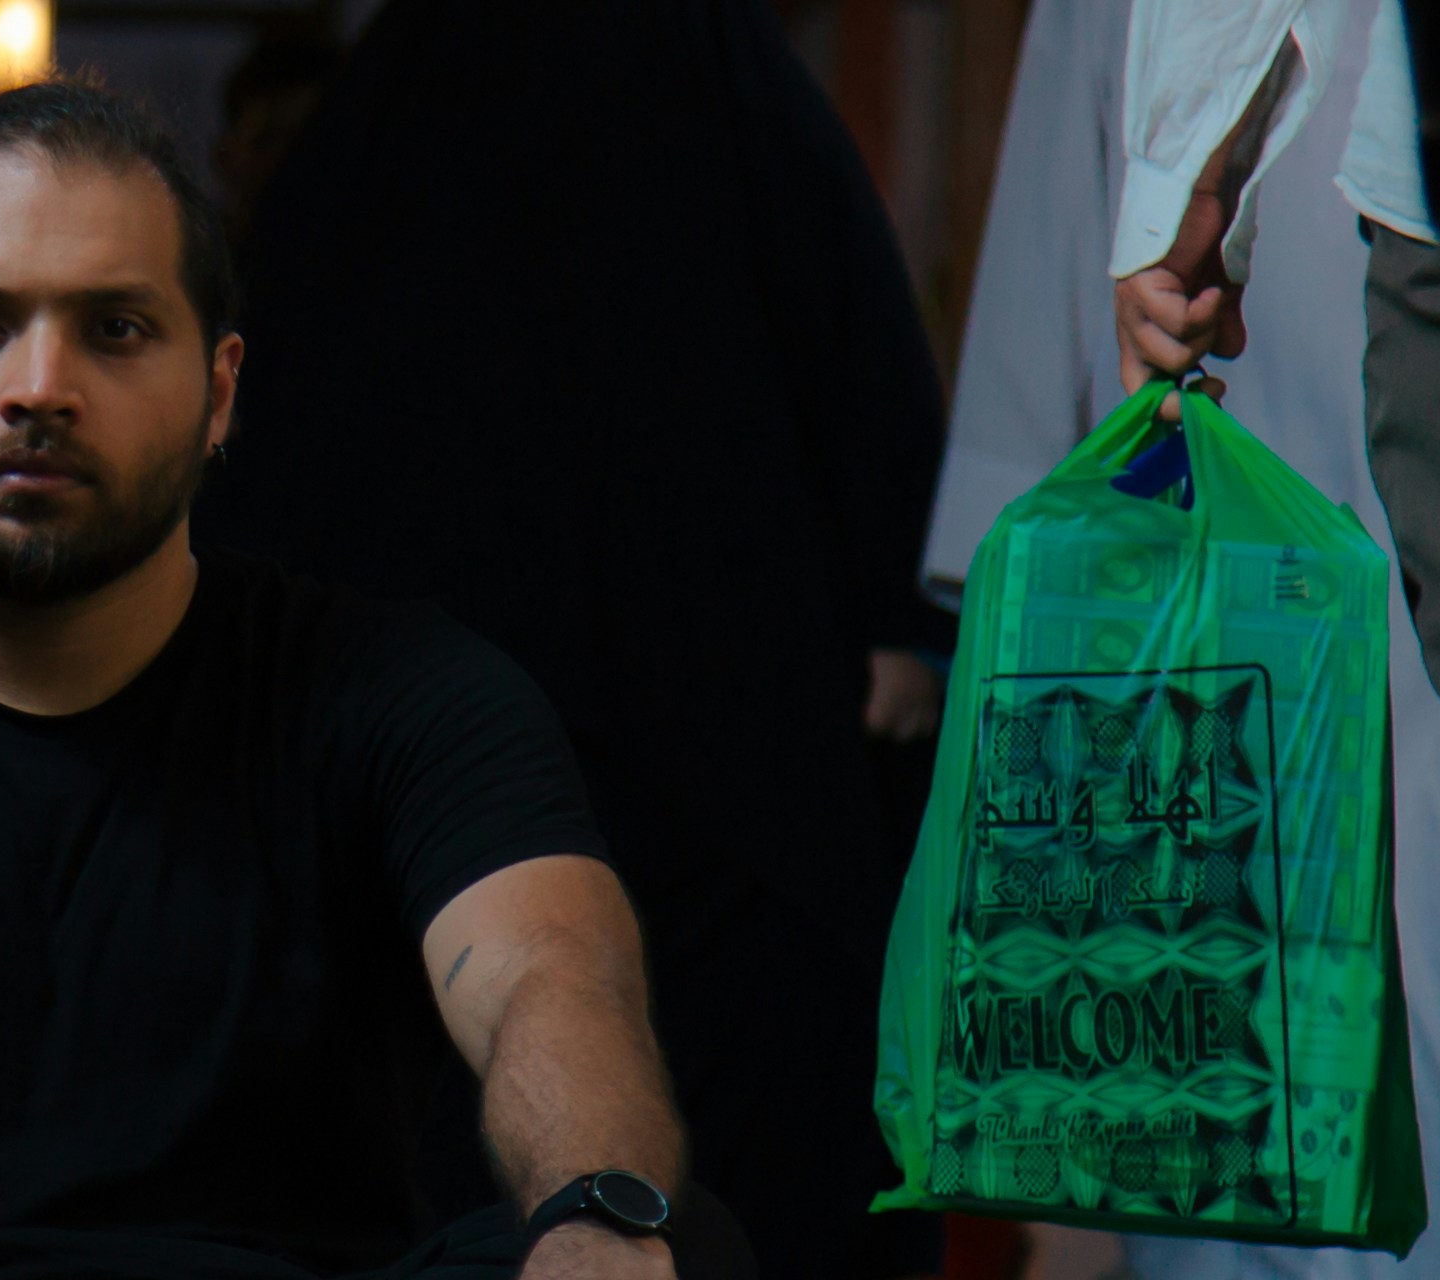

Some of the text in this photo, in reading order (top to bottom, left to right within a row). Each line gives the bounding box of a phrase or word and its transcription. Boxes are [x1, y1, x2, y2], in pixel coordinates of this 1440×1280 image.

[953, 984, 1226, 1073] WELCOME
[976, 1111, 1061, 1145] Thanks
[1063, 1109, 1100, 1151] for
[1101, 1116, 1146, 1149] your
